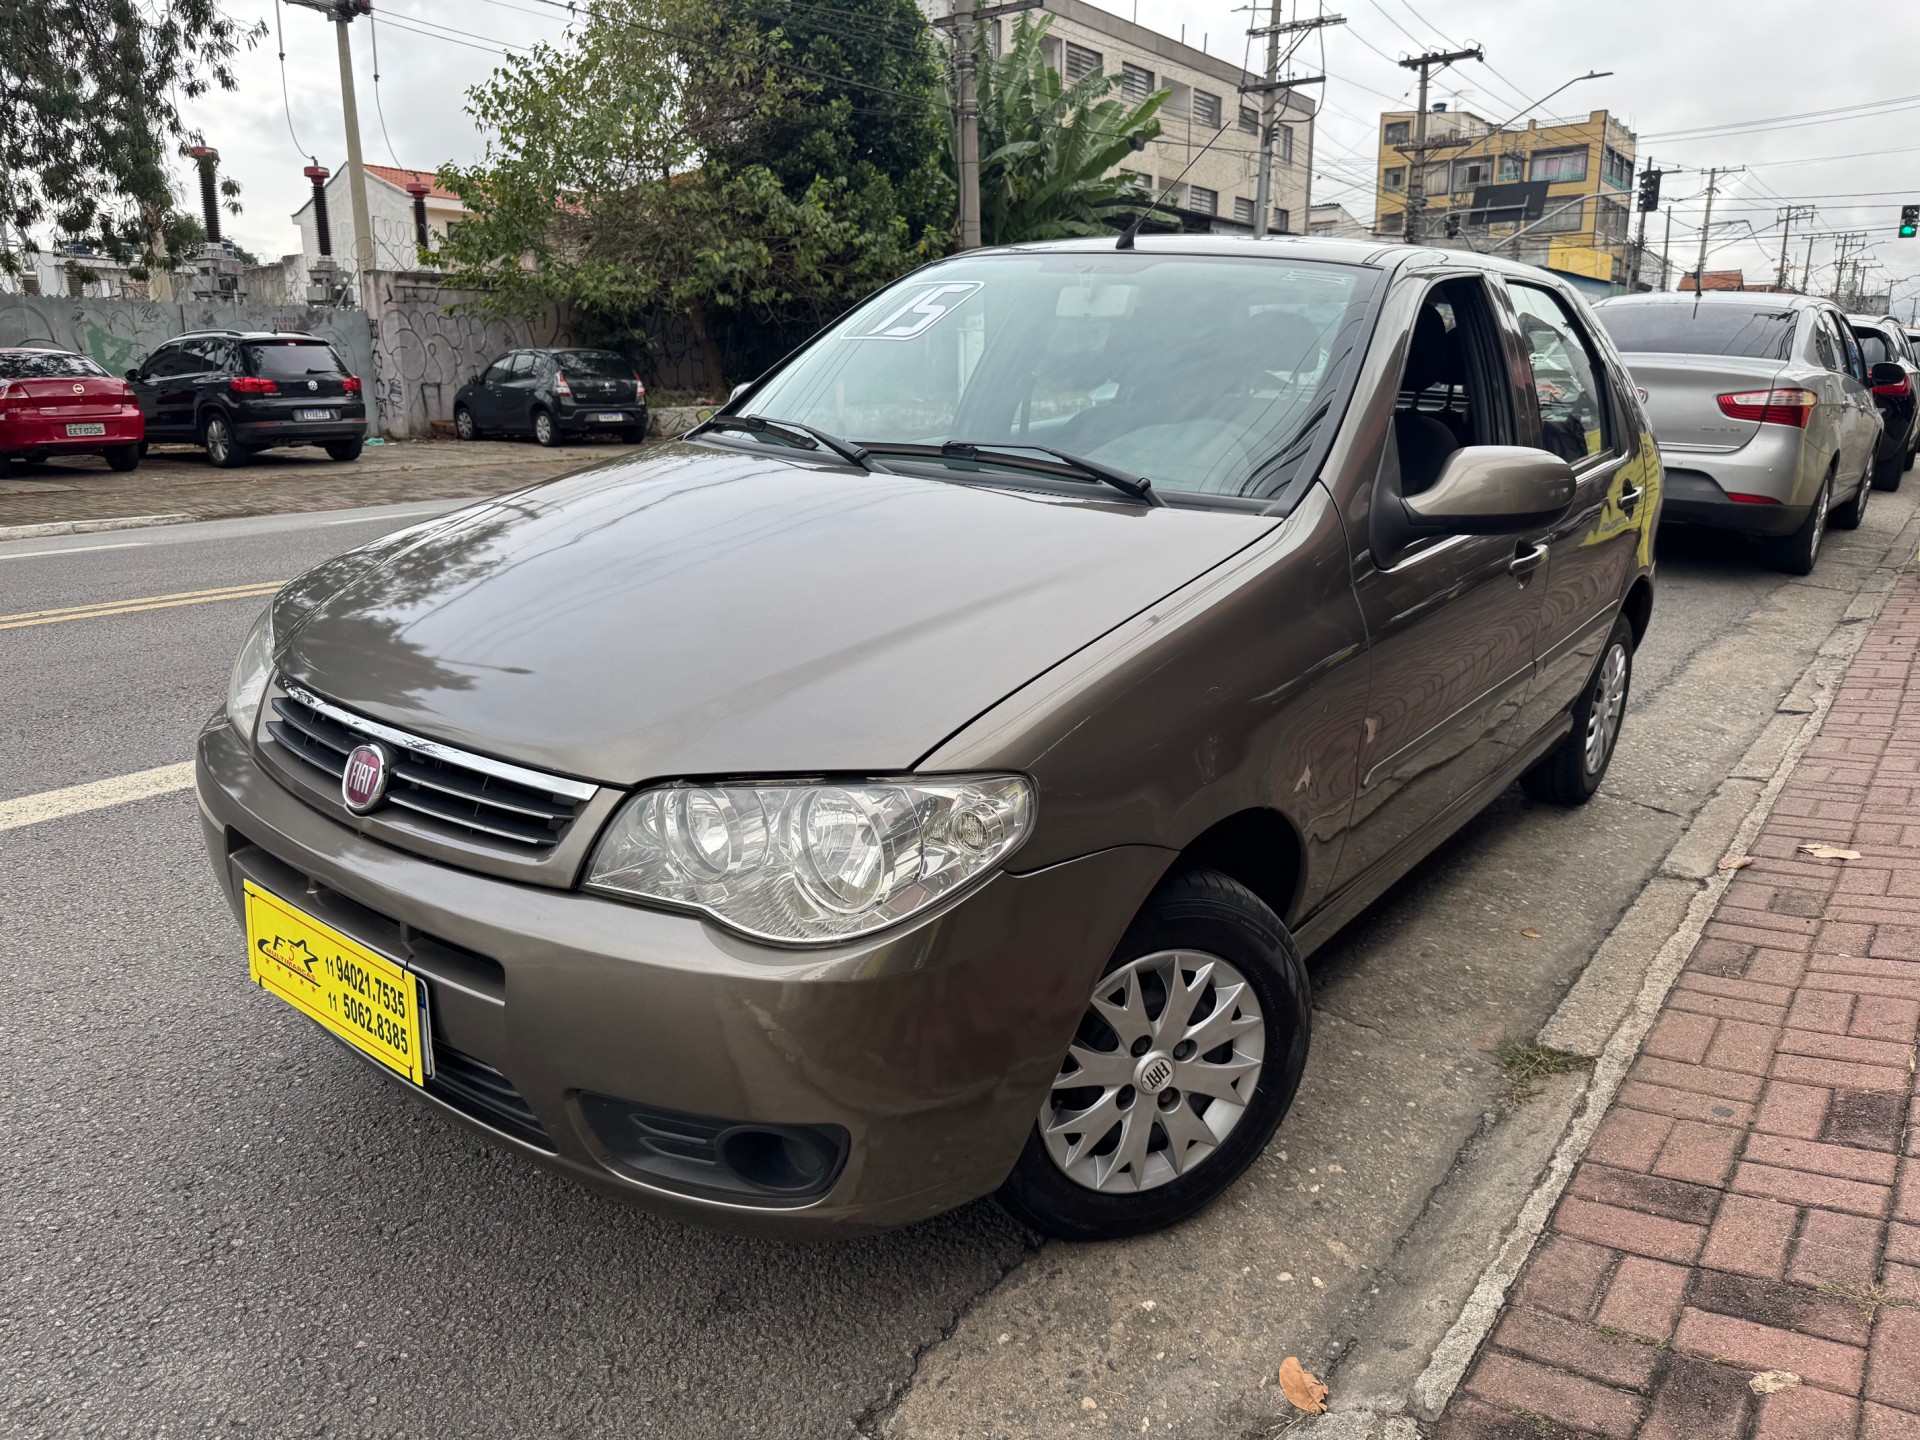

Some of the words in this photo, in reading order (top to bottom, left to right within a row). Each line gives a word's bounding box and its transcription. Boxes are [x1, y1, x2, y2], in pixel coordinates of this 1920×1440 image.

[867, 284, 975, 336] 15
[349, 760, 376, 794] FIAT
[266, 947, 316, 981] MULTIMARCAS
[326, 956, 334, 977] 11
[336, 955, 405, 1019] 94021.7535
[328, 992, 337, 1012] 11
[343, 993, 408, 1055] 5062.8385
[1145, 1061, 1171, 1090] FIAT
